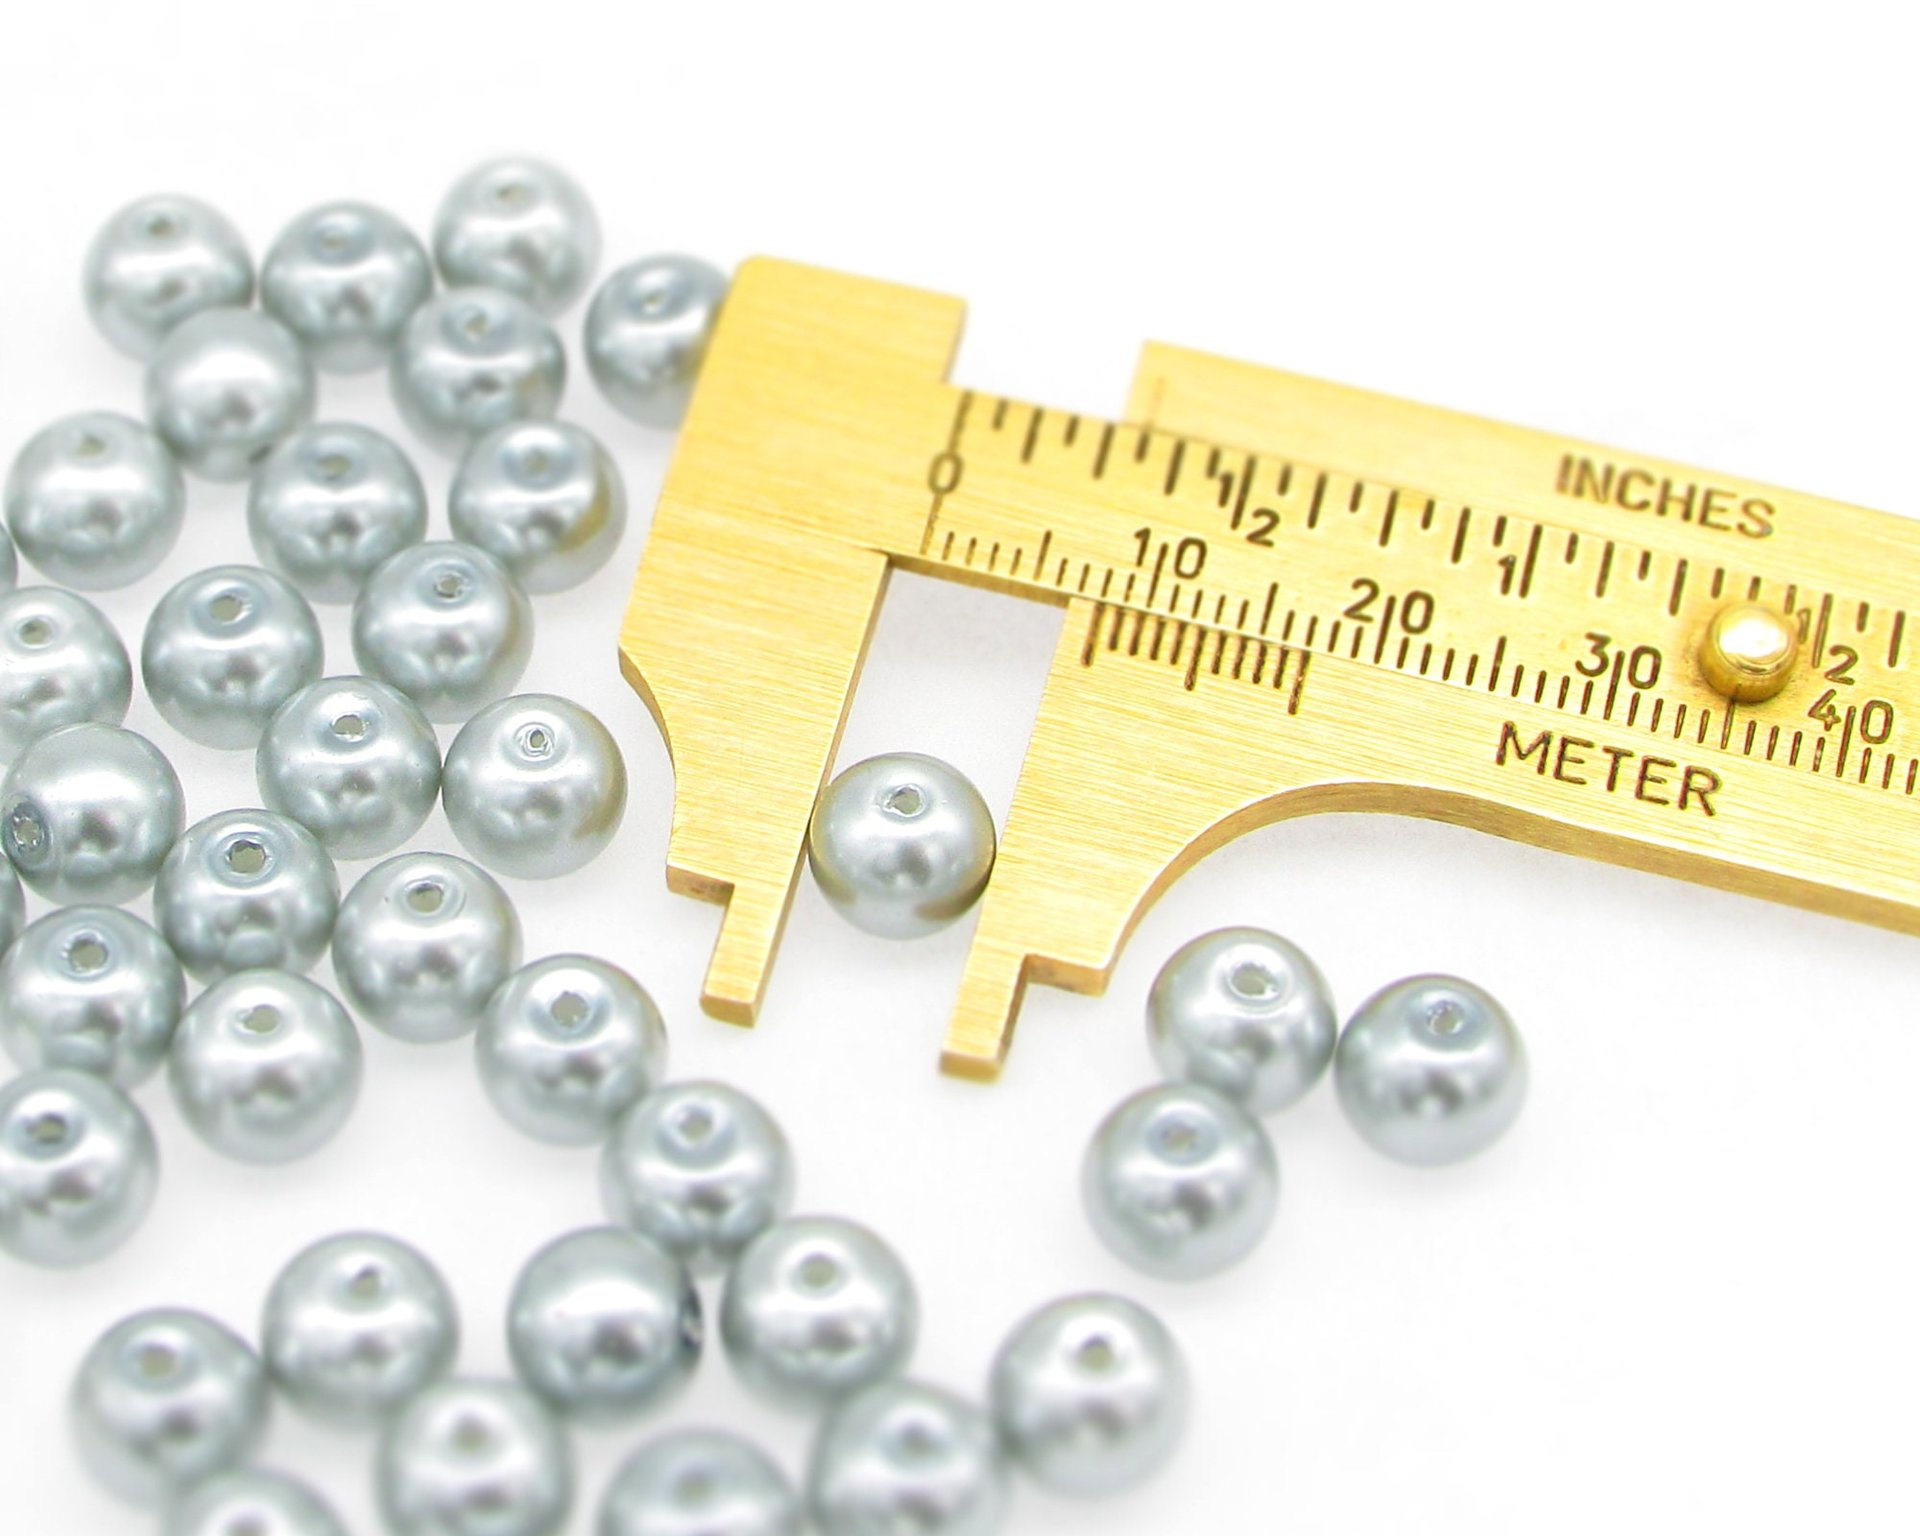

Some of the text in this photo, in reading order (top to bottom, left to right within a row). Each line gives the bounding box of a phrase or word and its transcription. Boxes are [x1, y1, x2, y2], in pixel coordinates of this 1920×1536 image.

[927, 451, 964, 496] 0
[1555, 453, 1776, 539] INCHES
[1134, 527, 1894, 744] 10 20 30 40
[1496, 721, 1722, 817] METER
